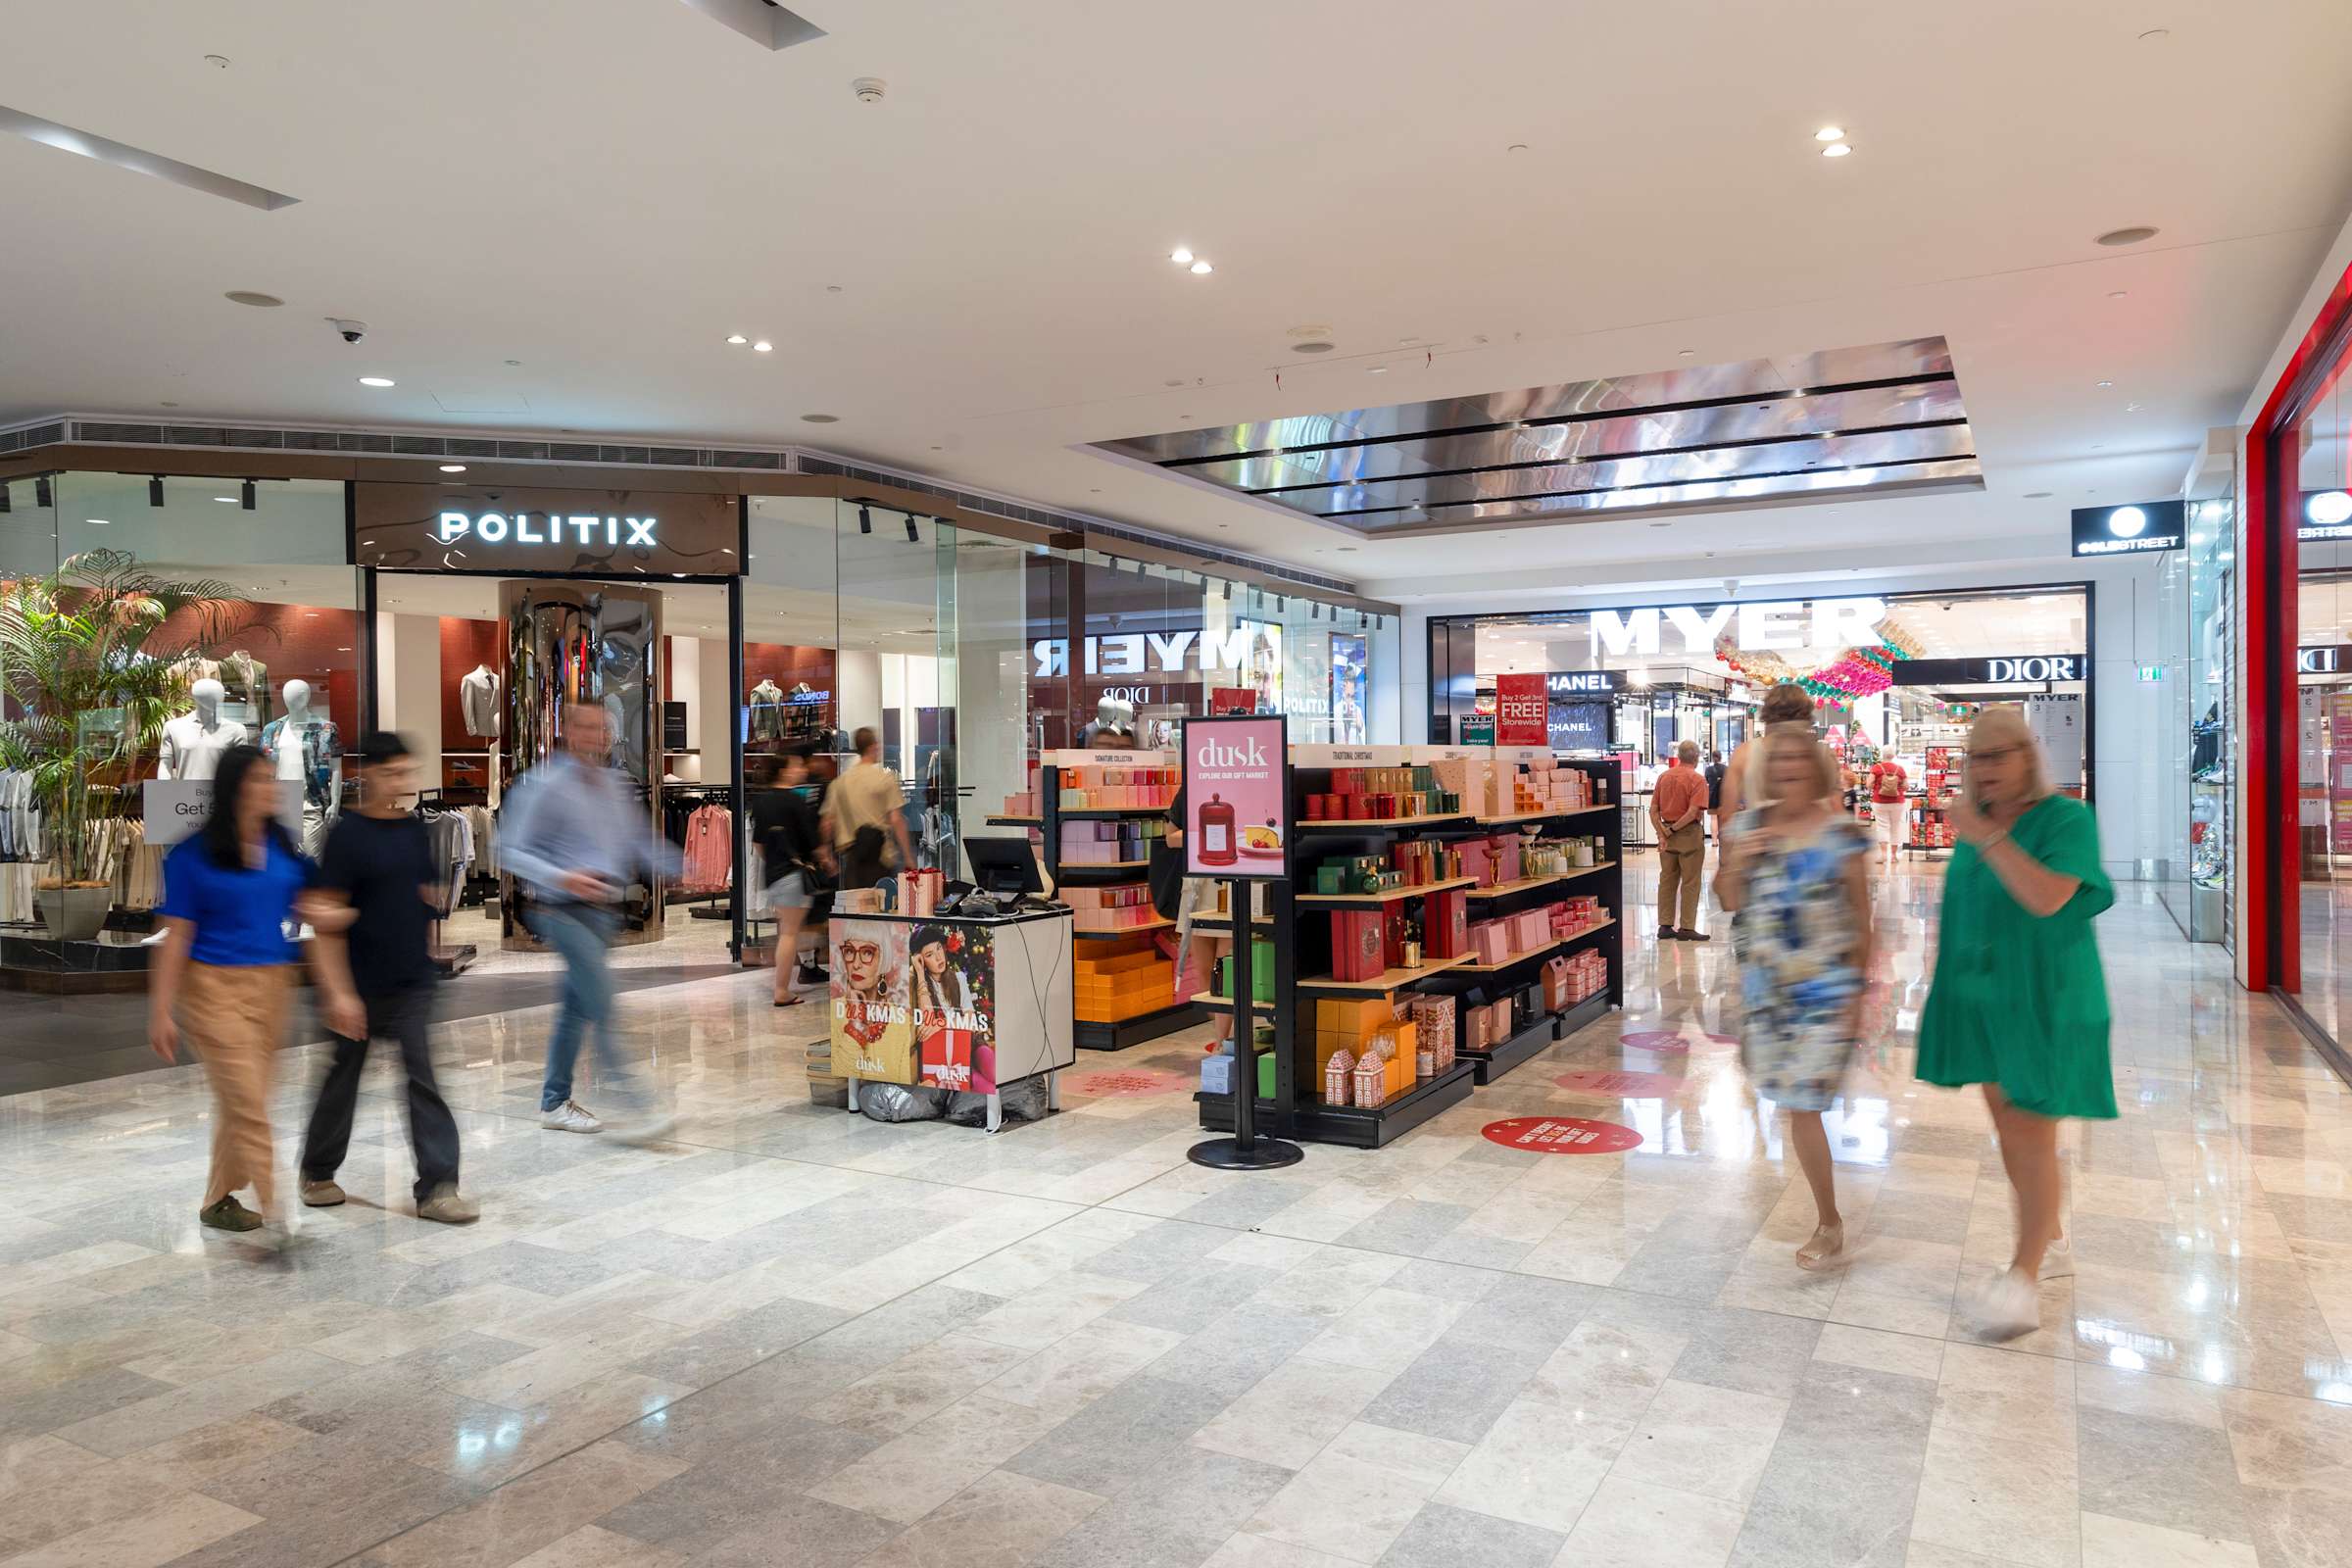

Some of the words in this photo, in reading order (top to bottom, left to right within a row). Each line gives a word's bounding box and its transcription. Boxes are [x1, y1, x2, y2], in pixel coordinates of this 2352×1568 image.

[440, 513, 657, 546] POLITIX
[1590, 598, 1887, 656] MYER
[1986, 658, 2074, 682] DIOR
[1547, 674, 1613, 691] HANEL
[1501, 703, 1543, 717] FREE
[1547, 722, 1592, 732] CHANEL
[1199, 736, 1269, 767] dusk
[174, 802, 205, 815] Get
